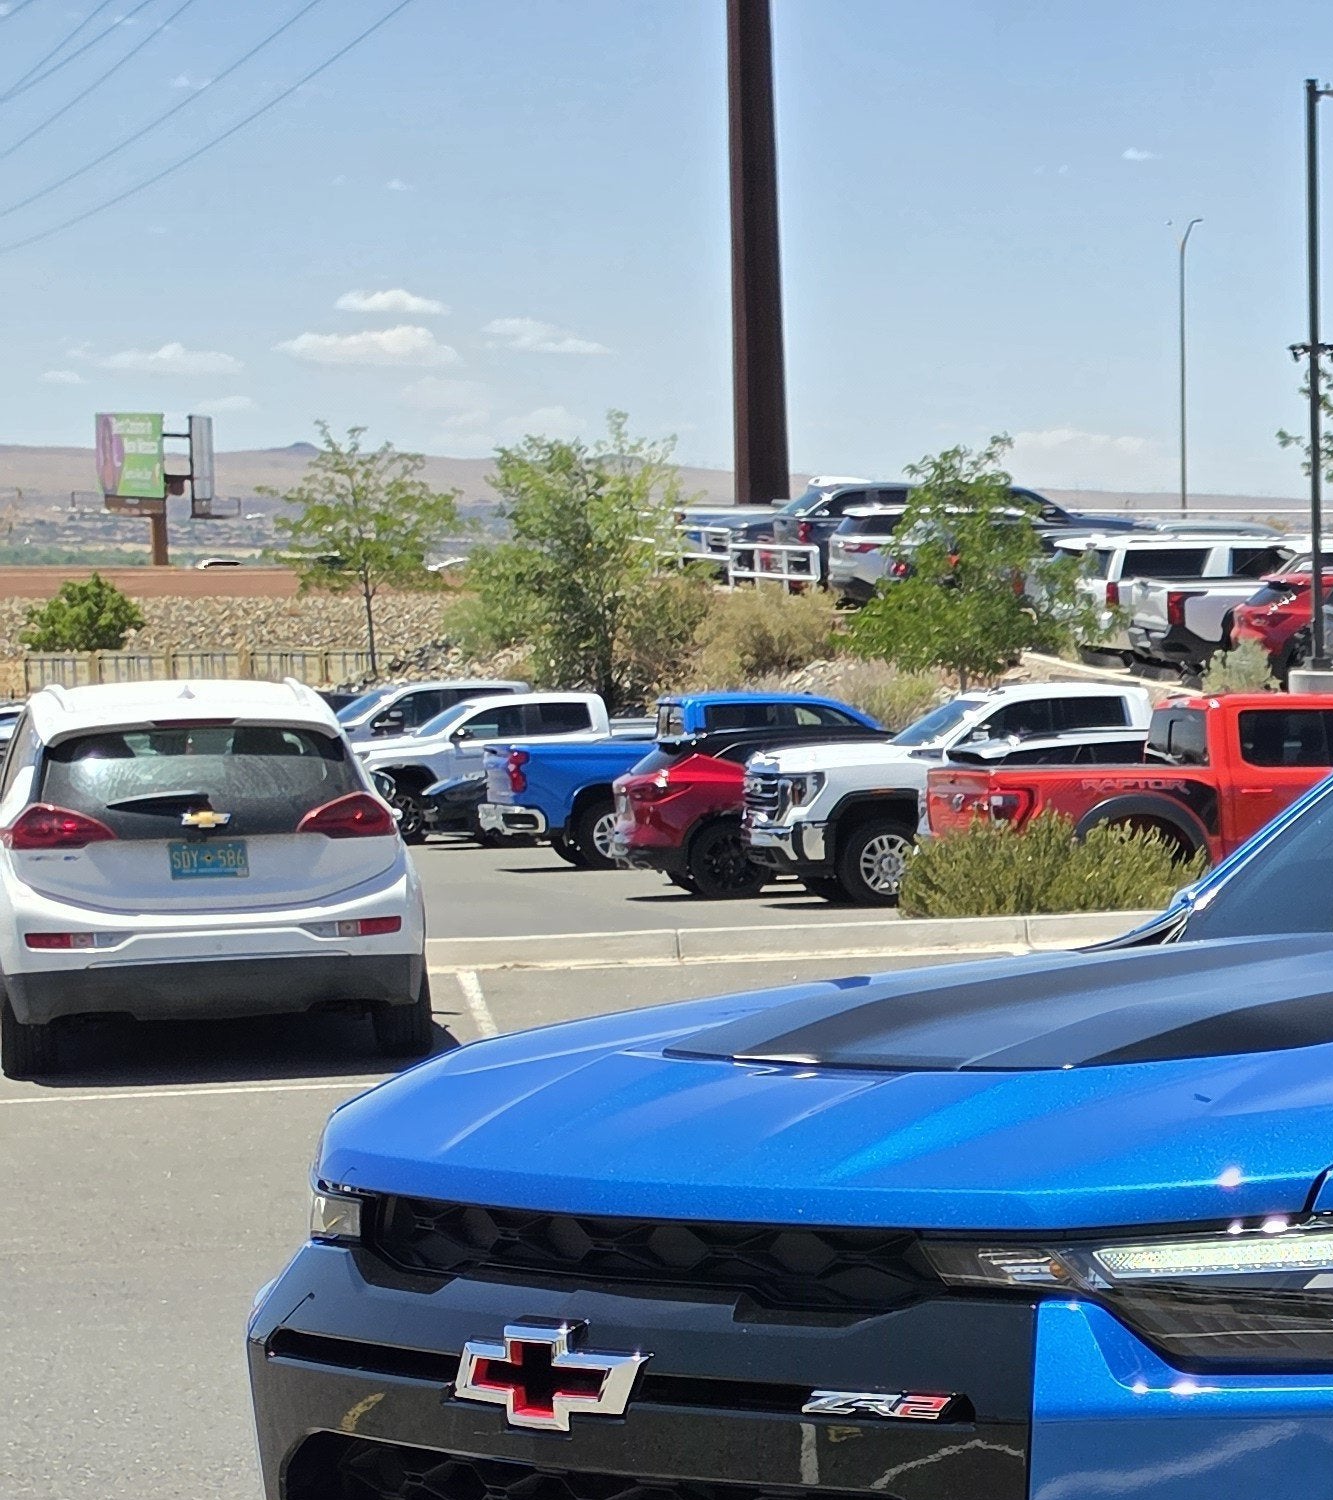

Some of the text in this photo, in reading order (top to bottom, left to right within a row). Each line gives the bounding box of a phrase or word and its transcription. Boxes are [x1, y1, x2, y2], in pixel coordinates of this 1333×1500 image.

[1081, 778, 1190, 795] RAPTOR
[217, 849, 245, 867] 586
[802, 1390, 952, 1420] ZR2
